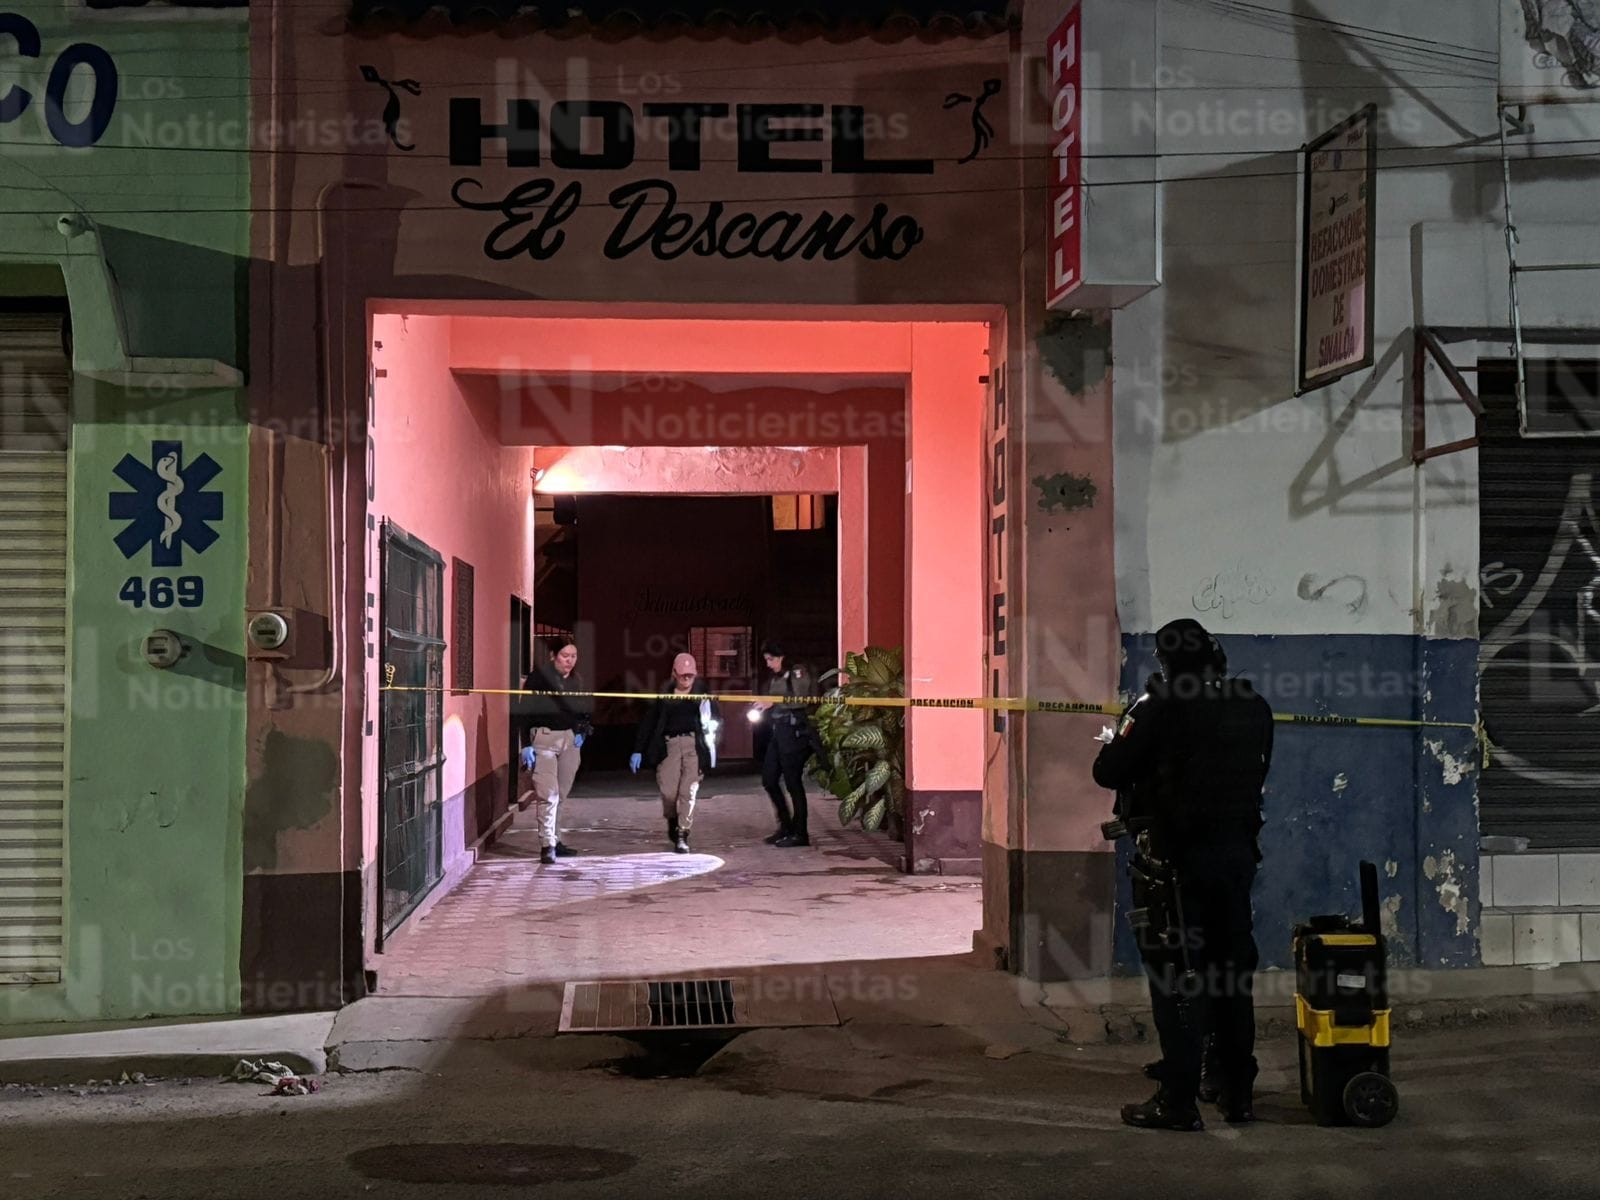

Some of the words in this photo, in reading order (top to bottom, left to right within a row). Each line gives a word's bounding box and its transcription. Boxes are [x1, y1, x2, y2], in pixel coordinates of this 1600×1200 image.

[449, 98, 934, 174] HOTEL
[1052, 24, 1076, 290] HOTEL
[451, 178, 582, 260] El
[603, 179, 924, 260] Descanso
[1332, 291, 1345, 327] DE
[1318, 325, 1355, 368] SINALOA
[993, 360, 1007, 733] HOTEL
[118, 575, 205, 609] 469
[910, 699, 974, 708] PRECAUCION
